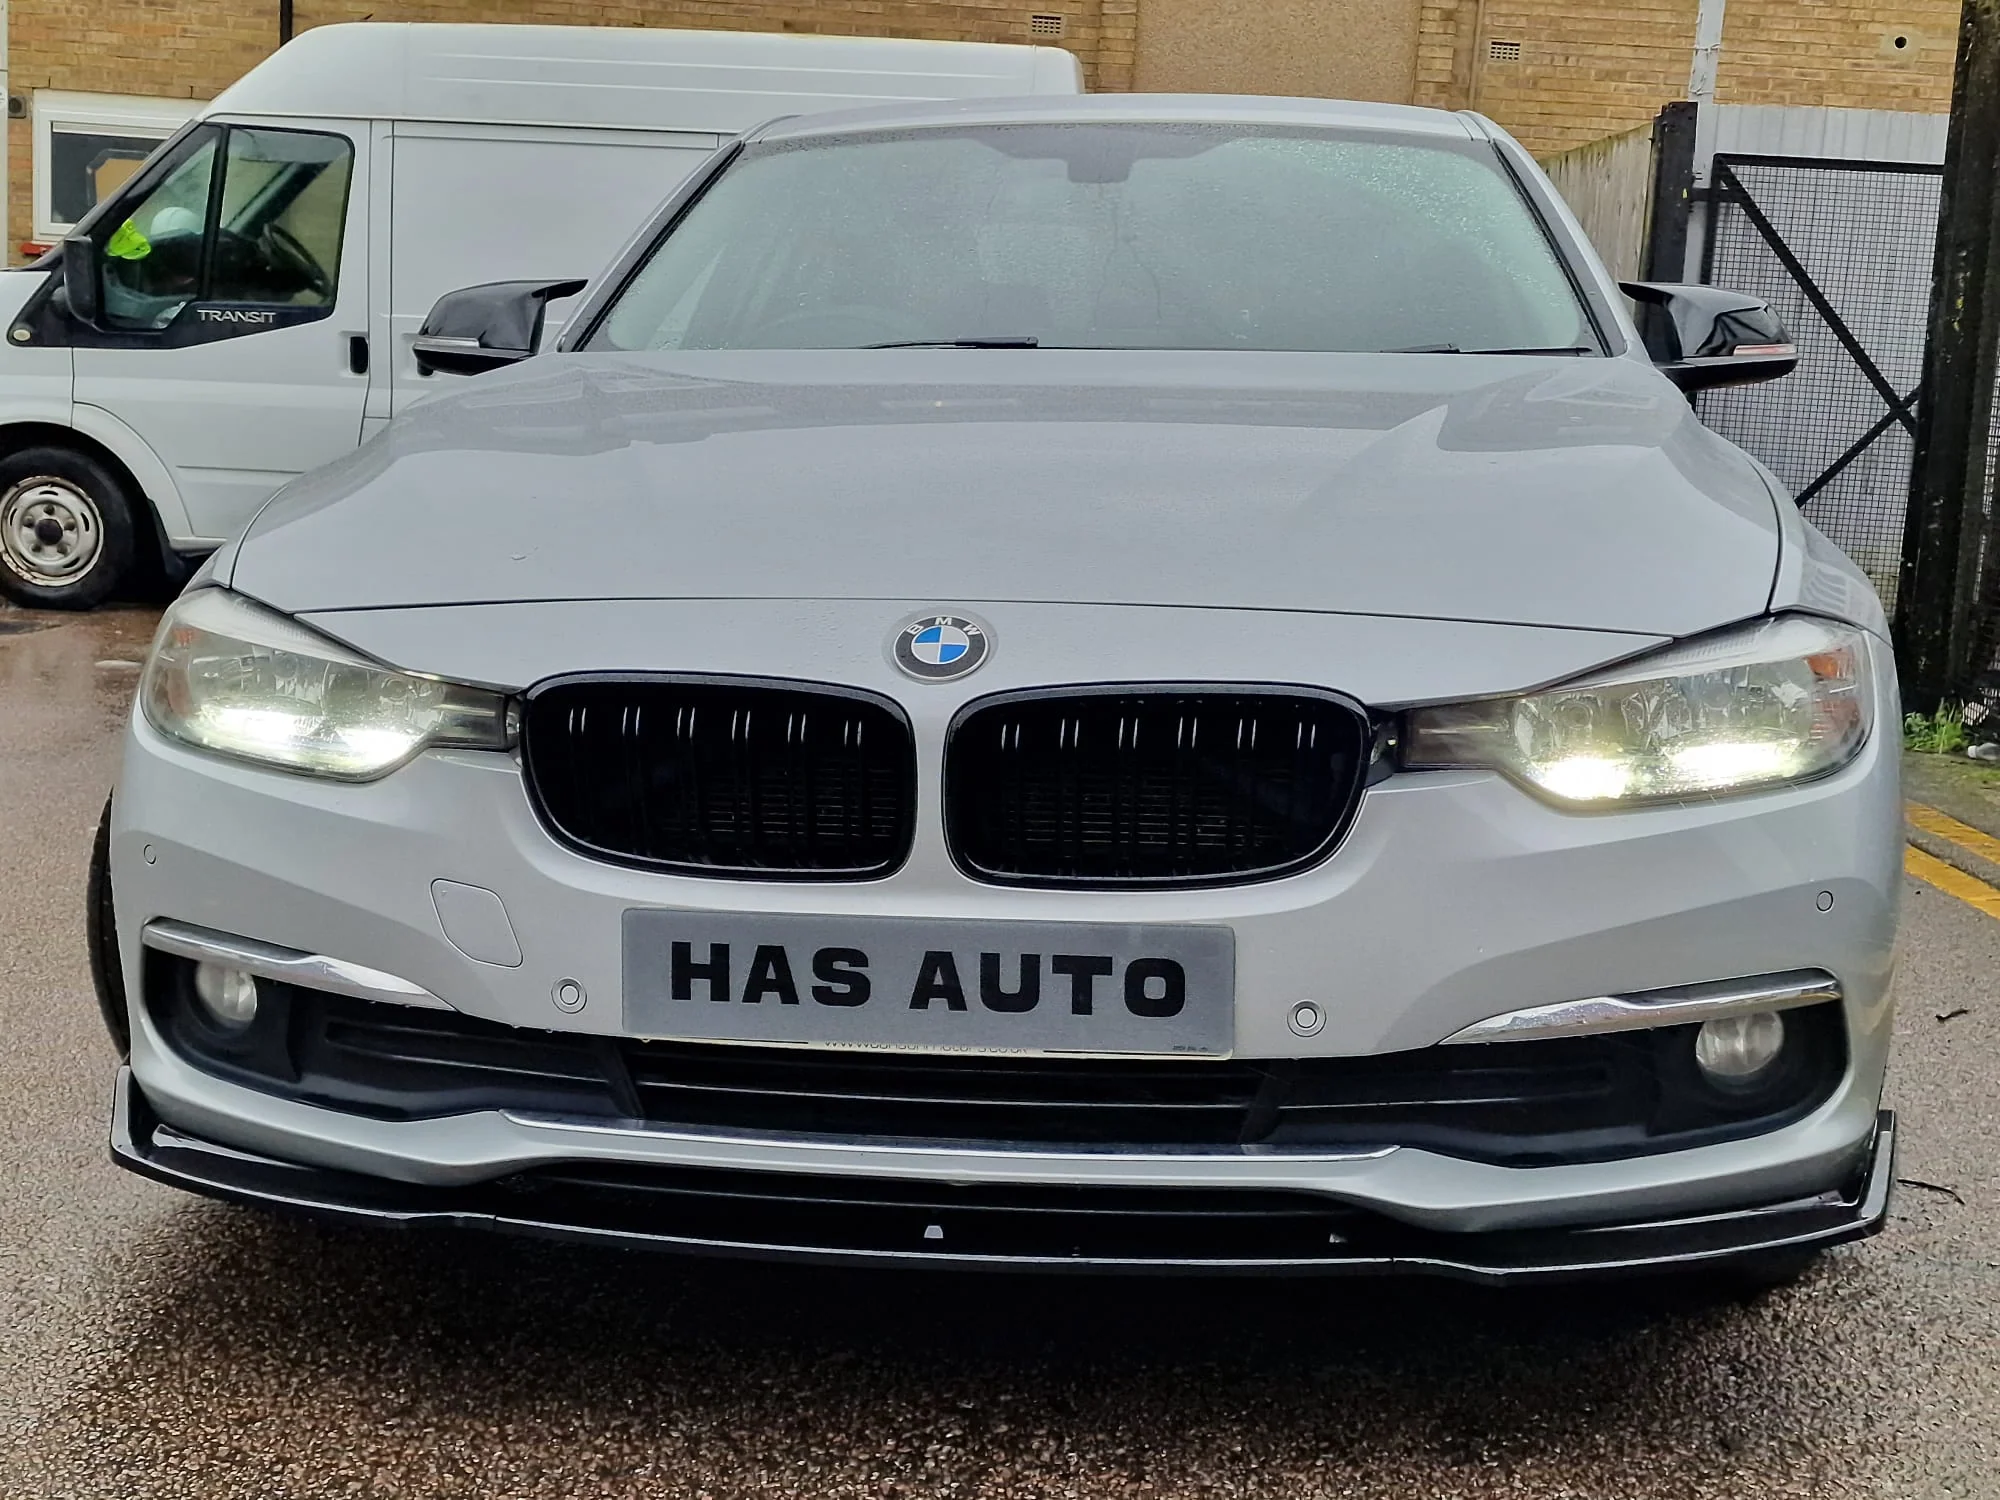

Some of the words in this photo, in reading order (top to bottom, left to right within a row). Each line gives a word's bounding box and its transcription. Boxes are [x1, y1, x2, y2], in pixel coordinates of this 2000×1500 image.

[197, 309, 276, 323] TRANSIT
[907, 617, 981, 636] BMW
[671, 941, 871, 1006] HAS
[909, 950, 1186, 1018] AUTO
